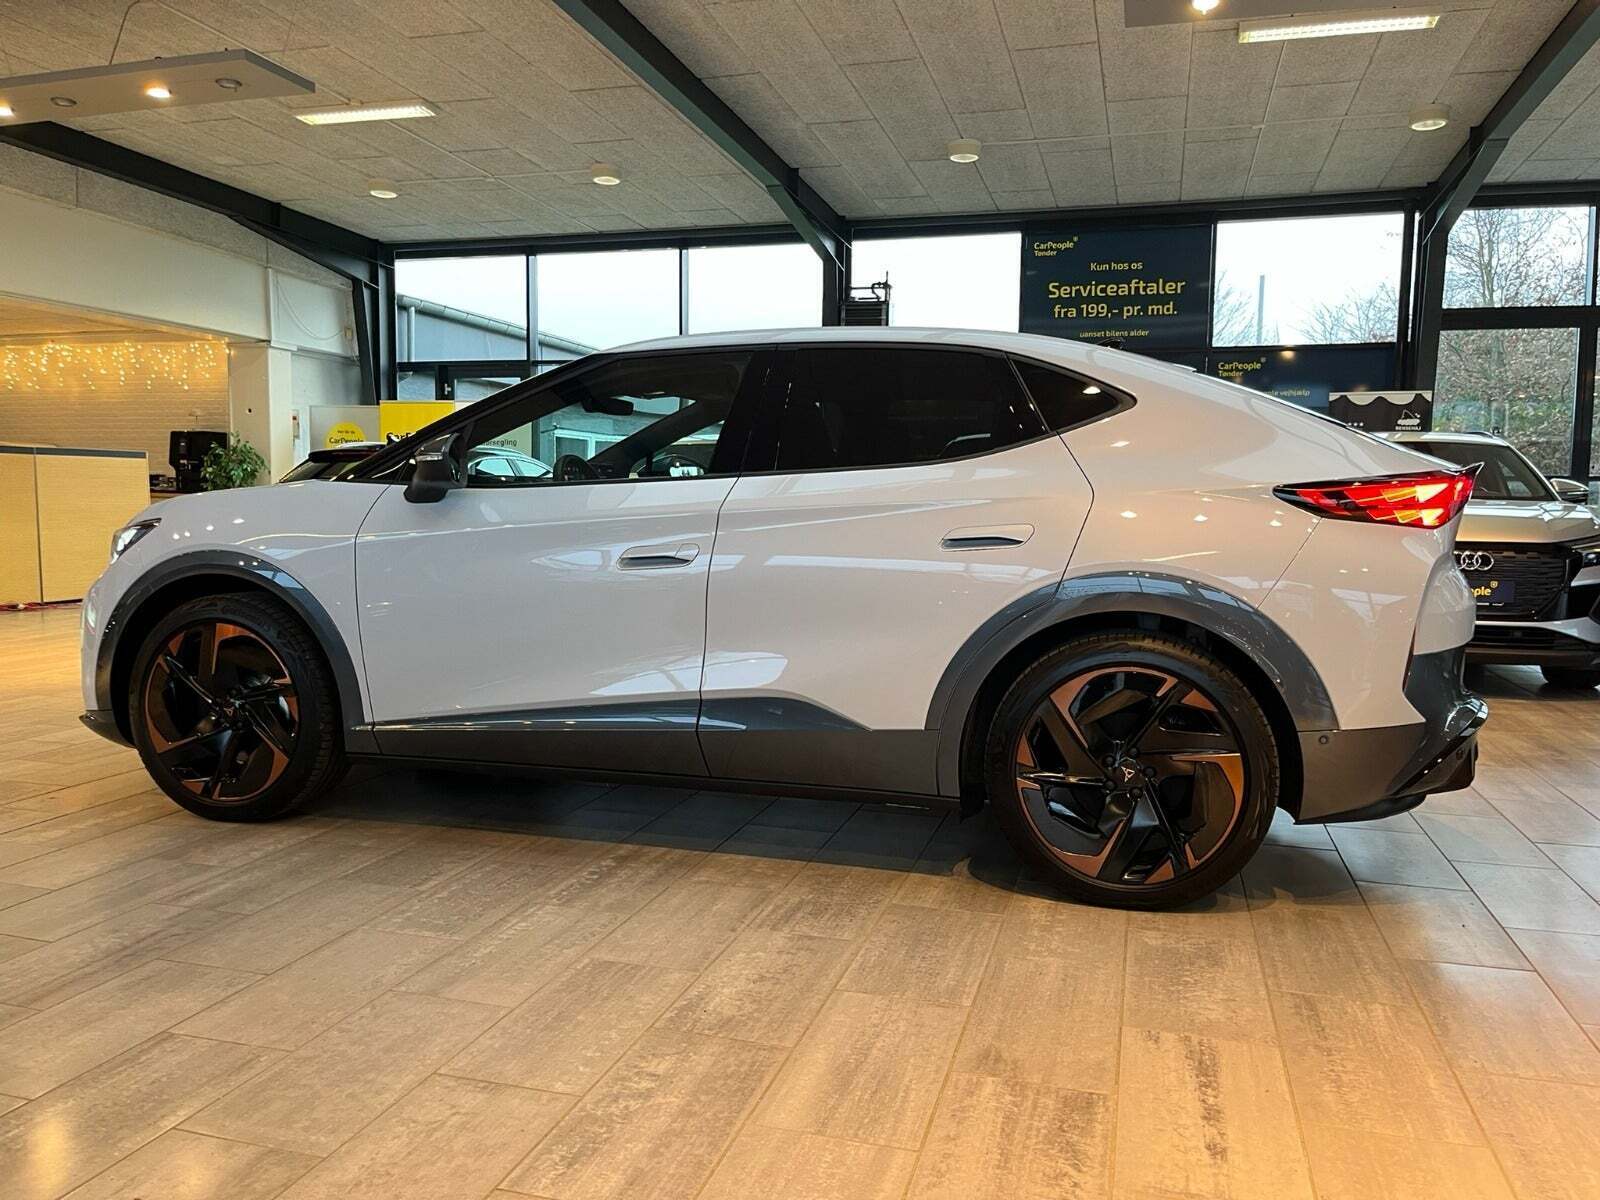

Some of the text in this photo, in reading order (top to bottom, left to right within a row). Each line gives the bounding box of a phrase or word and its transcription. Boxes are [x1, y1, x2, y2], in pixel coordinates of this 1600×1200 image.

[1034, 241, 1074, 251] CarPeople
[1090, 261, 1143, 271] Kun hos os
[1048, 278, 1186, 298] Serviceaftaler
[1054, 301, 1178, 319] fra 199,- pr. md.
[1080, 328, 1150, 338] uanset bilens alder
[1218, 361, 1262, 371] CarPeople
